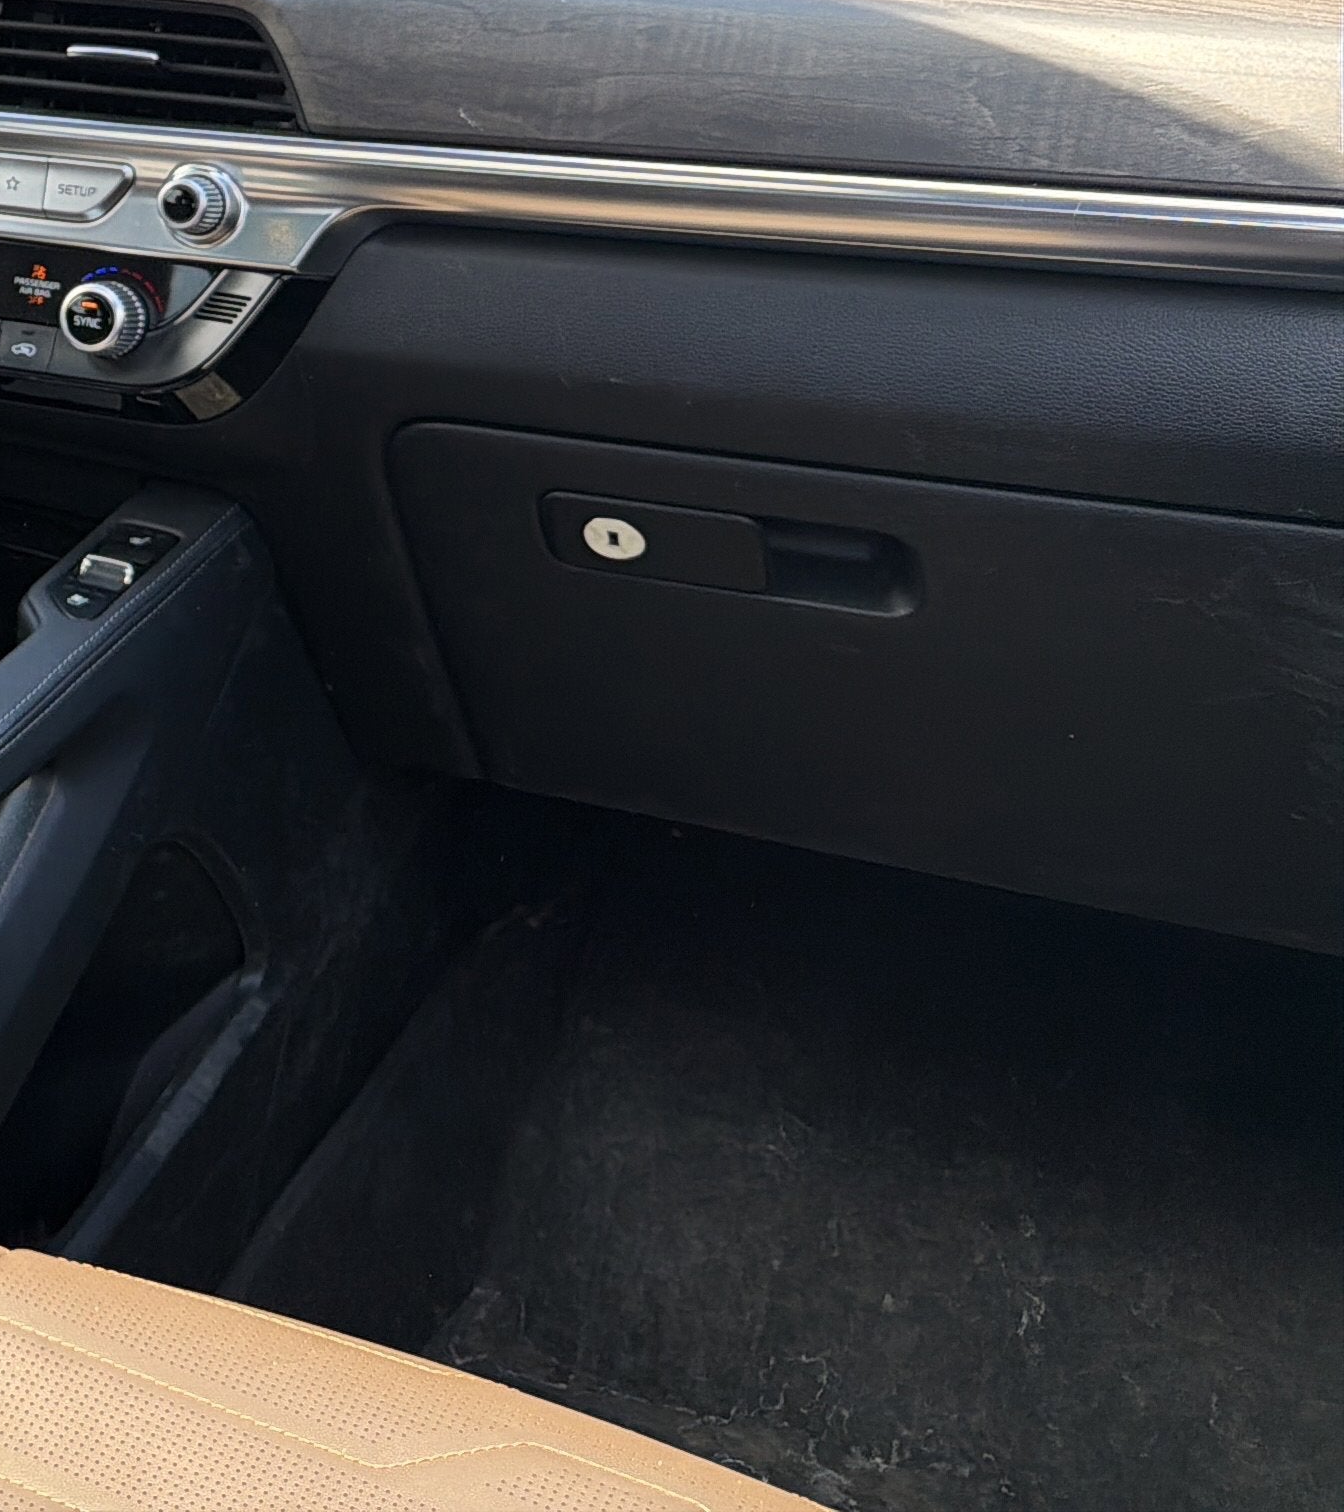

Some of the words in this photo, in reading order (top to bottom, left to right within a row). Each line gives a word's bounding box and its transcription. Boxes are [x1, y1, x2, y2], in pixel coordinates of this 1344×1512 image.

[57, 183, 96, 197] SETUP
[13, 276, 61, 290] PASSENGER
[18, 286, 33, 295] AIR
[34, 288, 51, 298] BAG
[72, 316, 102, 329] SYNC
